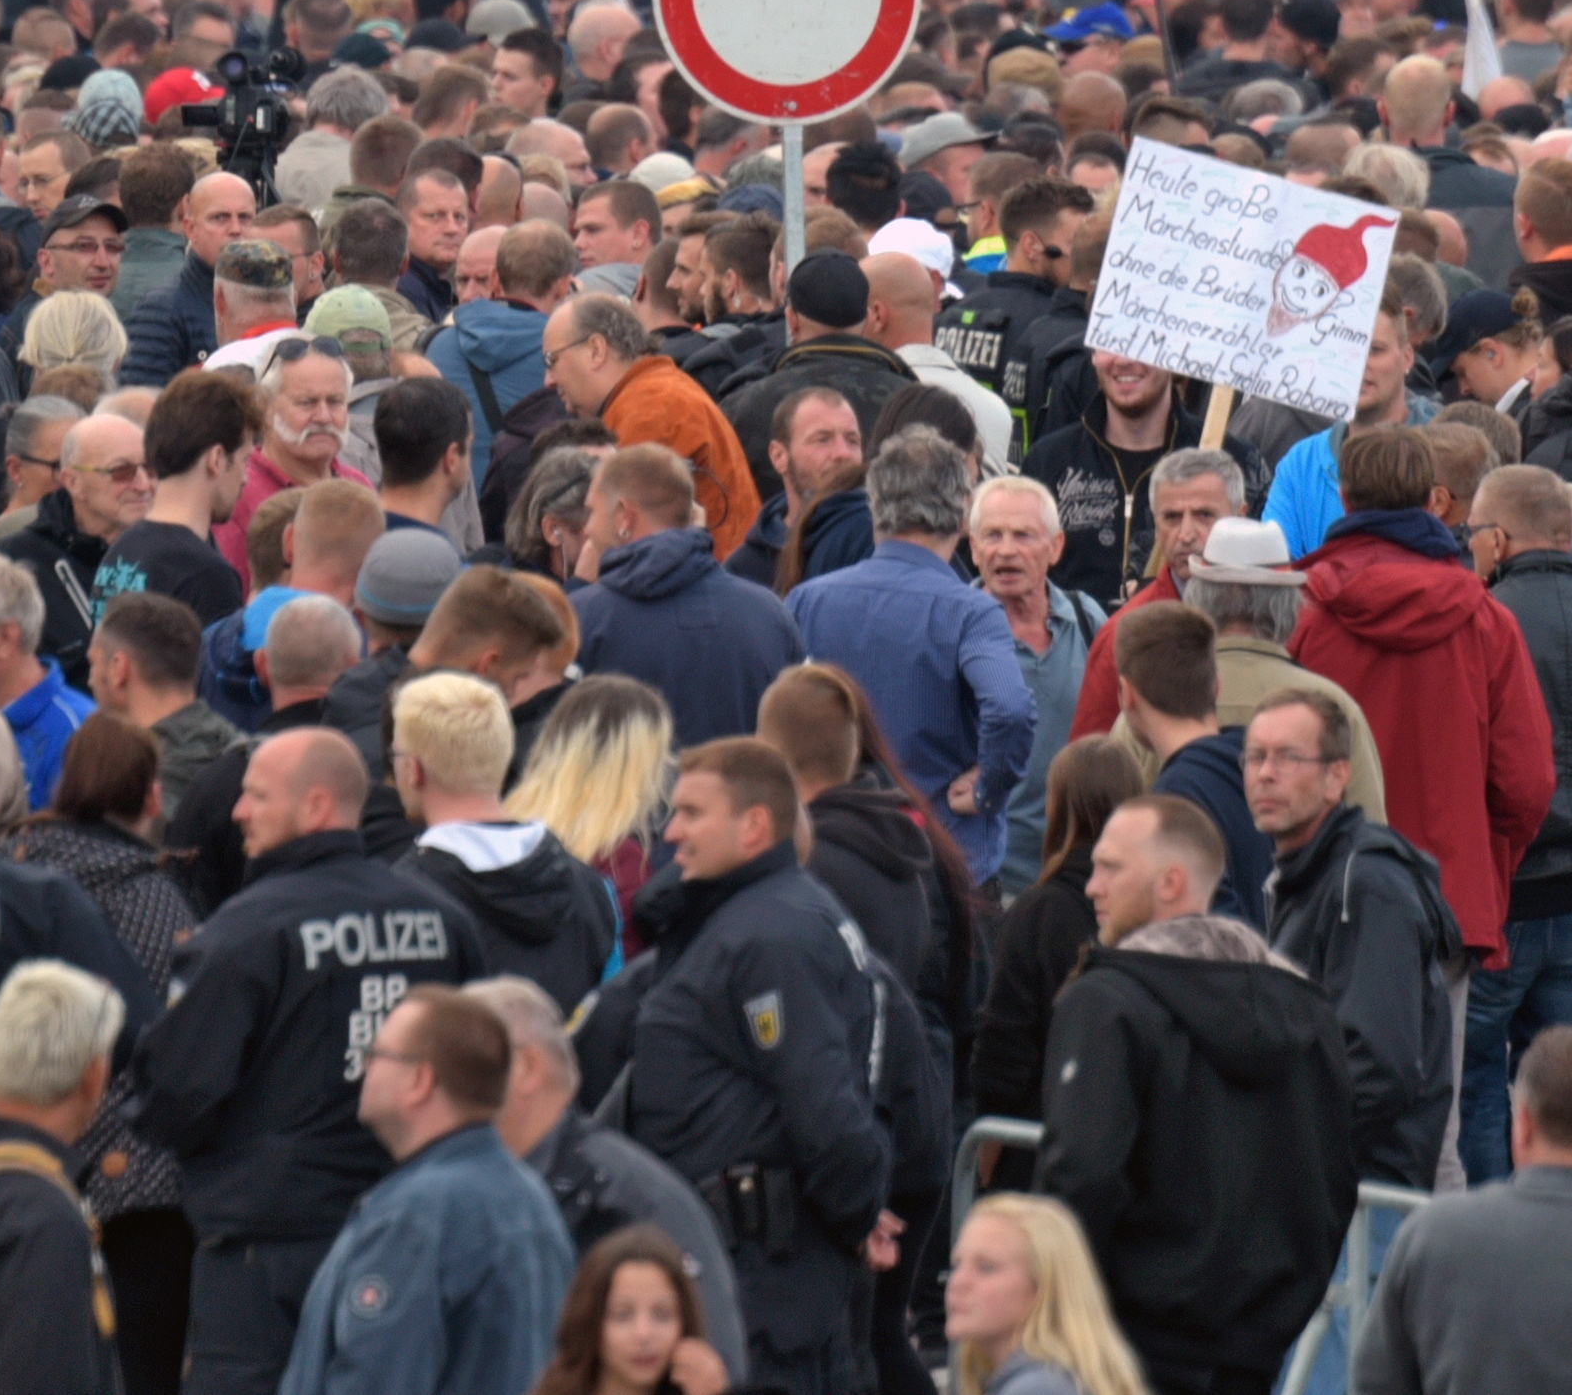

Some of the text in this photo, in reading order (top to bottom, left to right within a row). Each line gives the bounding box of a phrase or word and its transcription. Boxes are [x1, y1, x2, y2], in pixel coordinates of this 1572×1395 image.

[1128, 151, 1198, 201] Heute
[1098, 279, 1284, 362] Märchenerzähler
[1108, 246, 1370, 348] ohne die Brüder Grimm
[934, 326, 1002, 369] POLIZEI
[1271, 365, 1351, 421] Babara
[299, 910, 448, 970] POLIZEI
[360, 973, 408, 1012] BP
